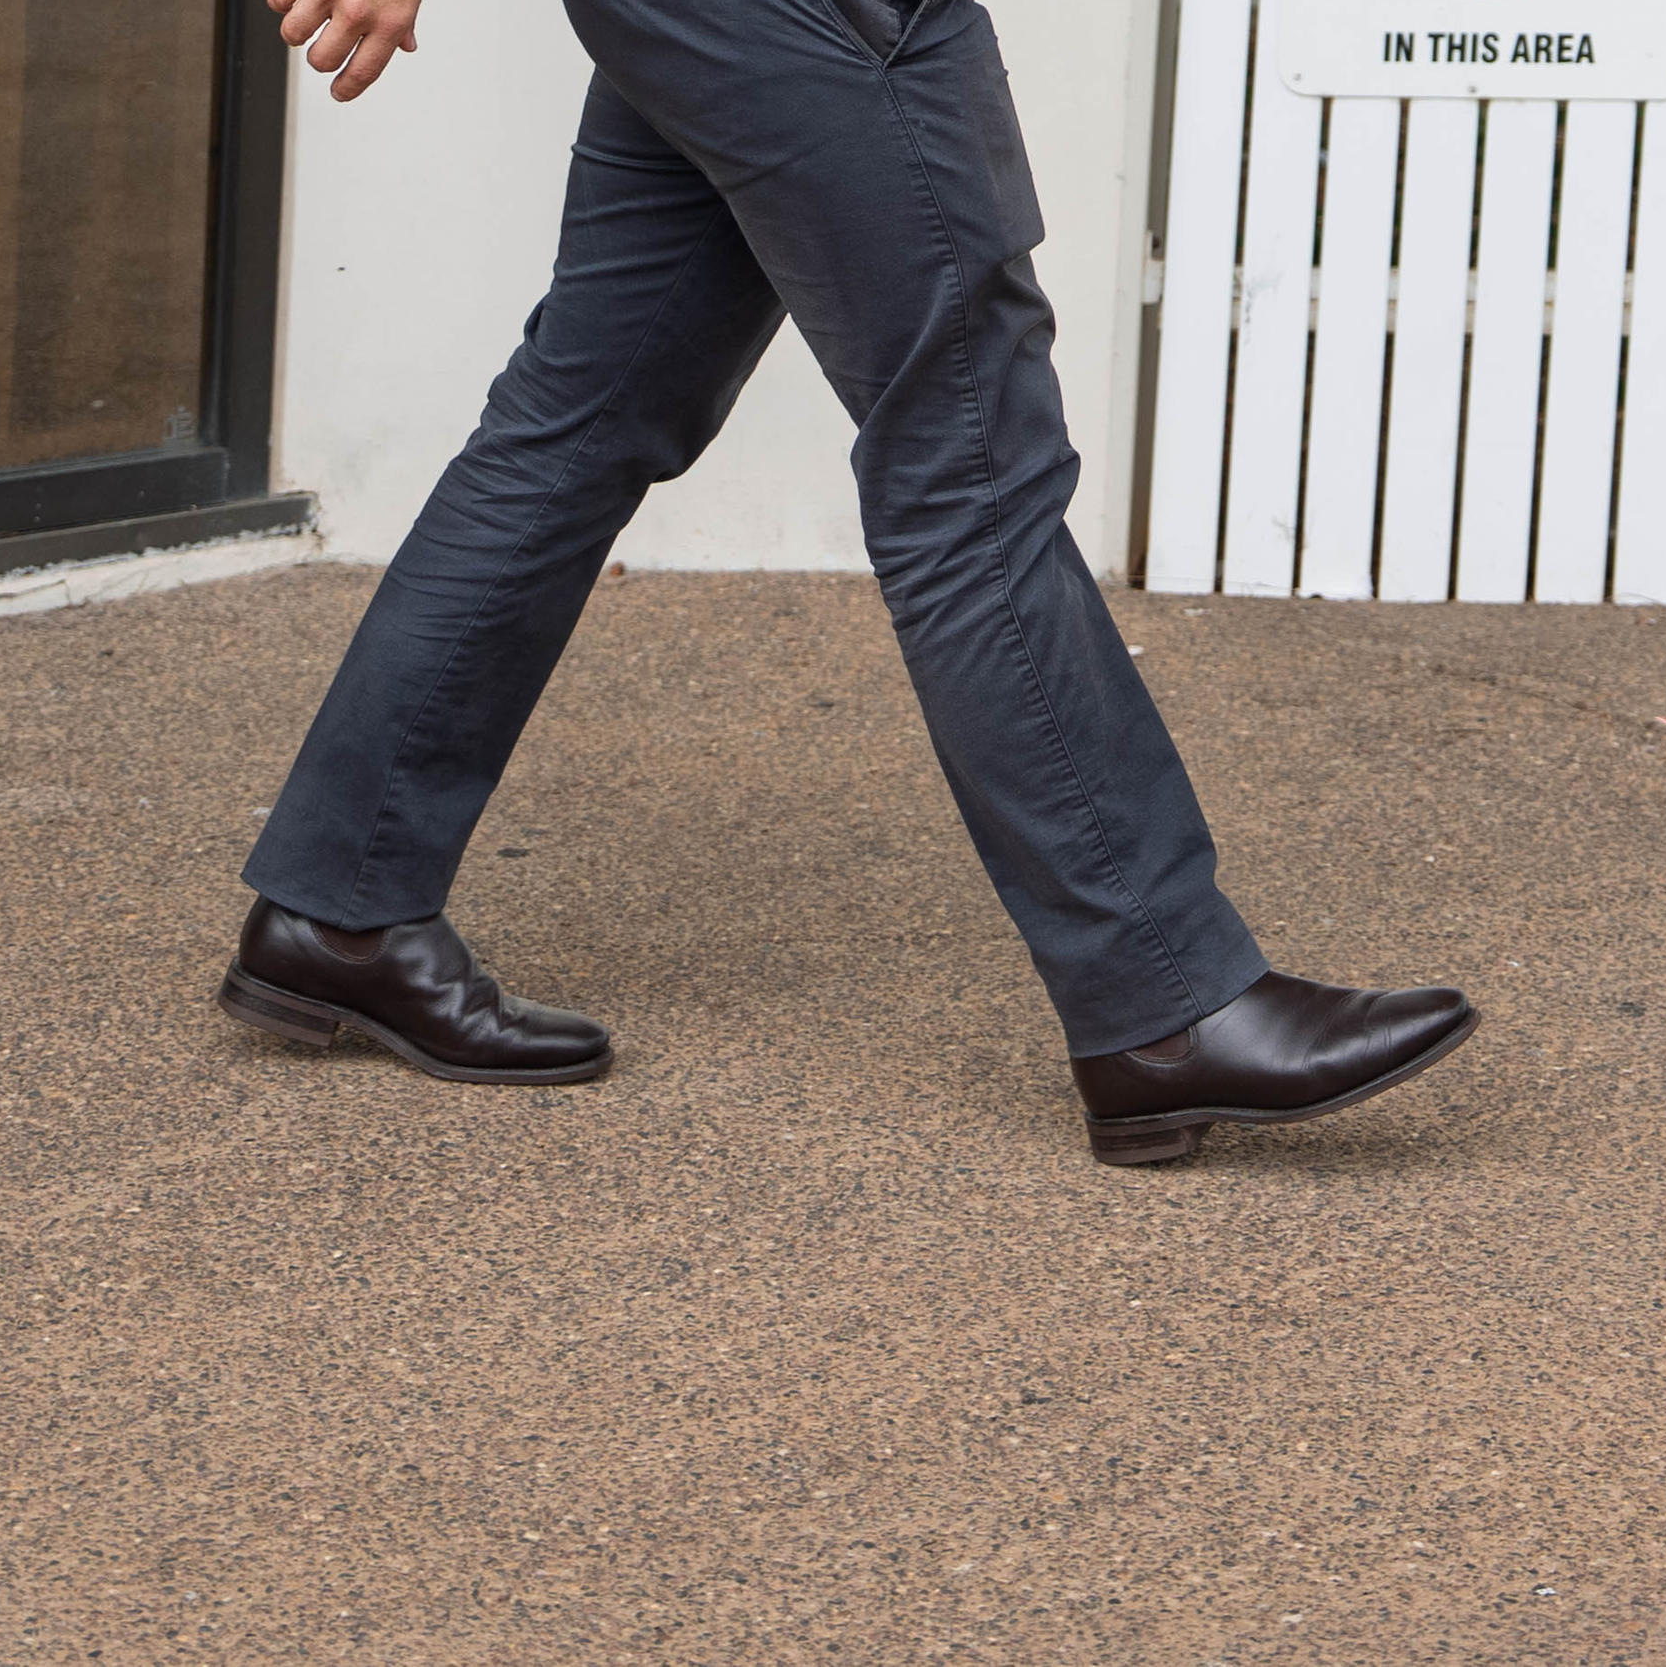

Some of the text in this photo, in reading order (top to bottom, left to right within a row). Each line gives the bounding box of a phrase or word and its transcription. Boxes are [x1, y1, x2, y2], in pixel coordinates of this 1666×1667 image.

[1384, 33, 1594, 64] IN THIS AREA
